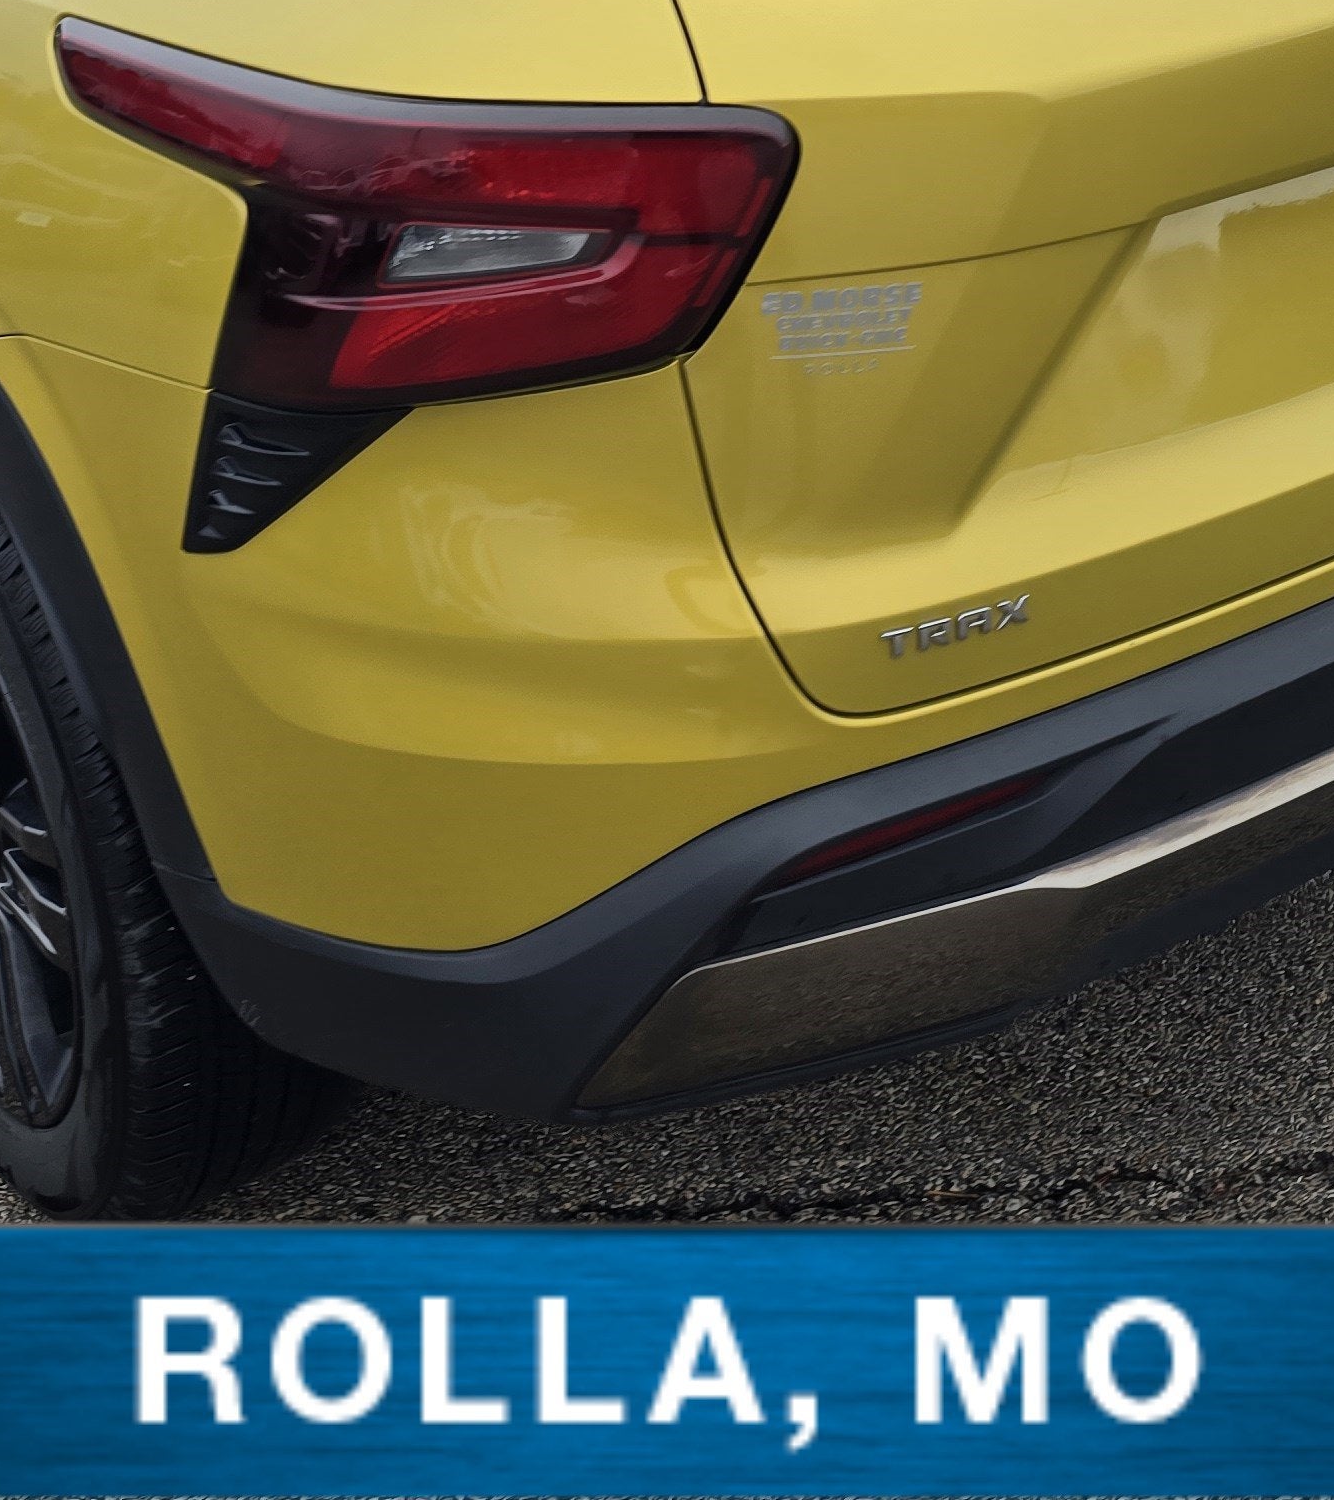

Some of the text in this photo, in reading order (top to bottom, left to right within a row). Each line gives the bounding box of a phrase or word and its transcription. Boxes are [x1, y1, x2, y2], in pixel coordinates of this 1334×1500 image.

[761, 281, 923, 315] ED MORSE
[880, 594, 1030, 659] TRAX
